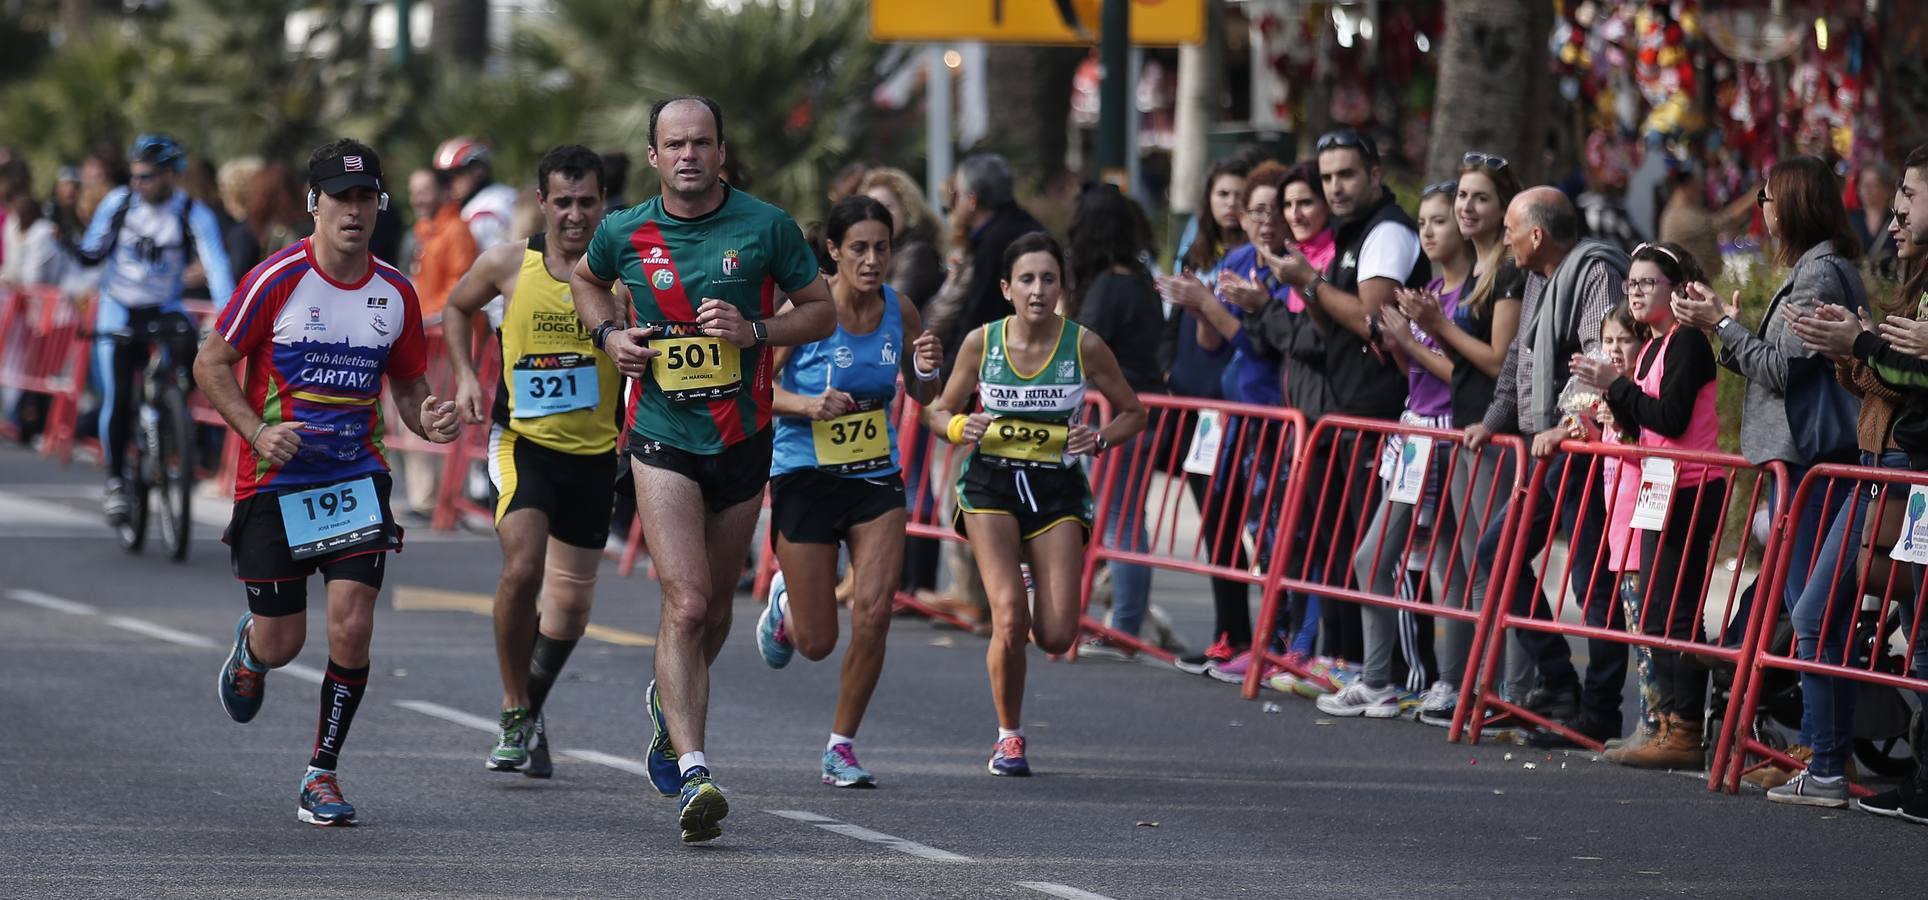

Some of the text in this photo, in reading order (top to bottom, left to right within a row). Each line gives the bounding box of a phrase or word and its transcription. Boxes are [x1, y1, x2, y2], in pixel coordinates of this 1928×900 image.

[643, 257, 669, 265] VIATOR
[533, 313, 576, 323] PLANET
[304, 352, 379, 368] Club Atletismo
[667, 343, 720, 370] 501
[529, 374, 577, 399] 321
[990, 388, 1067, 399] CAJA RURAL
[1011, 400, 1057, 408] GRANADA
[830, 418, 877, 446] 376
[302, 488, 358, 521] 195
[323, 684, 352, 748] Kalenji
